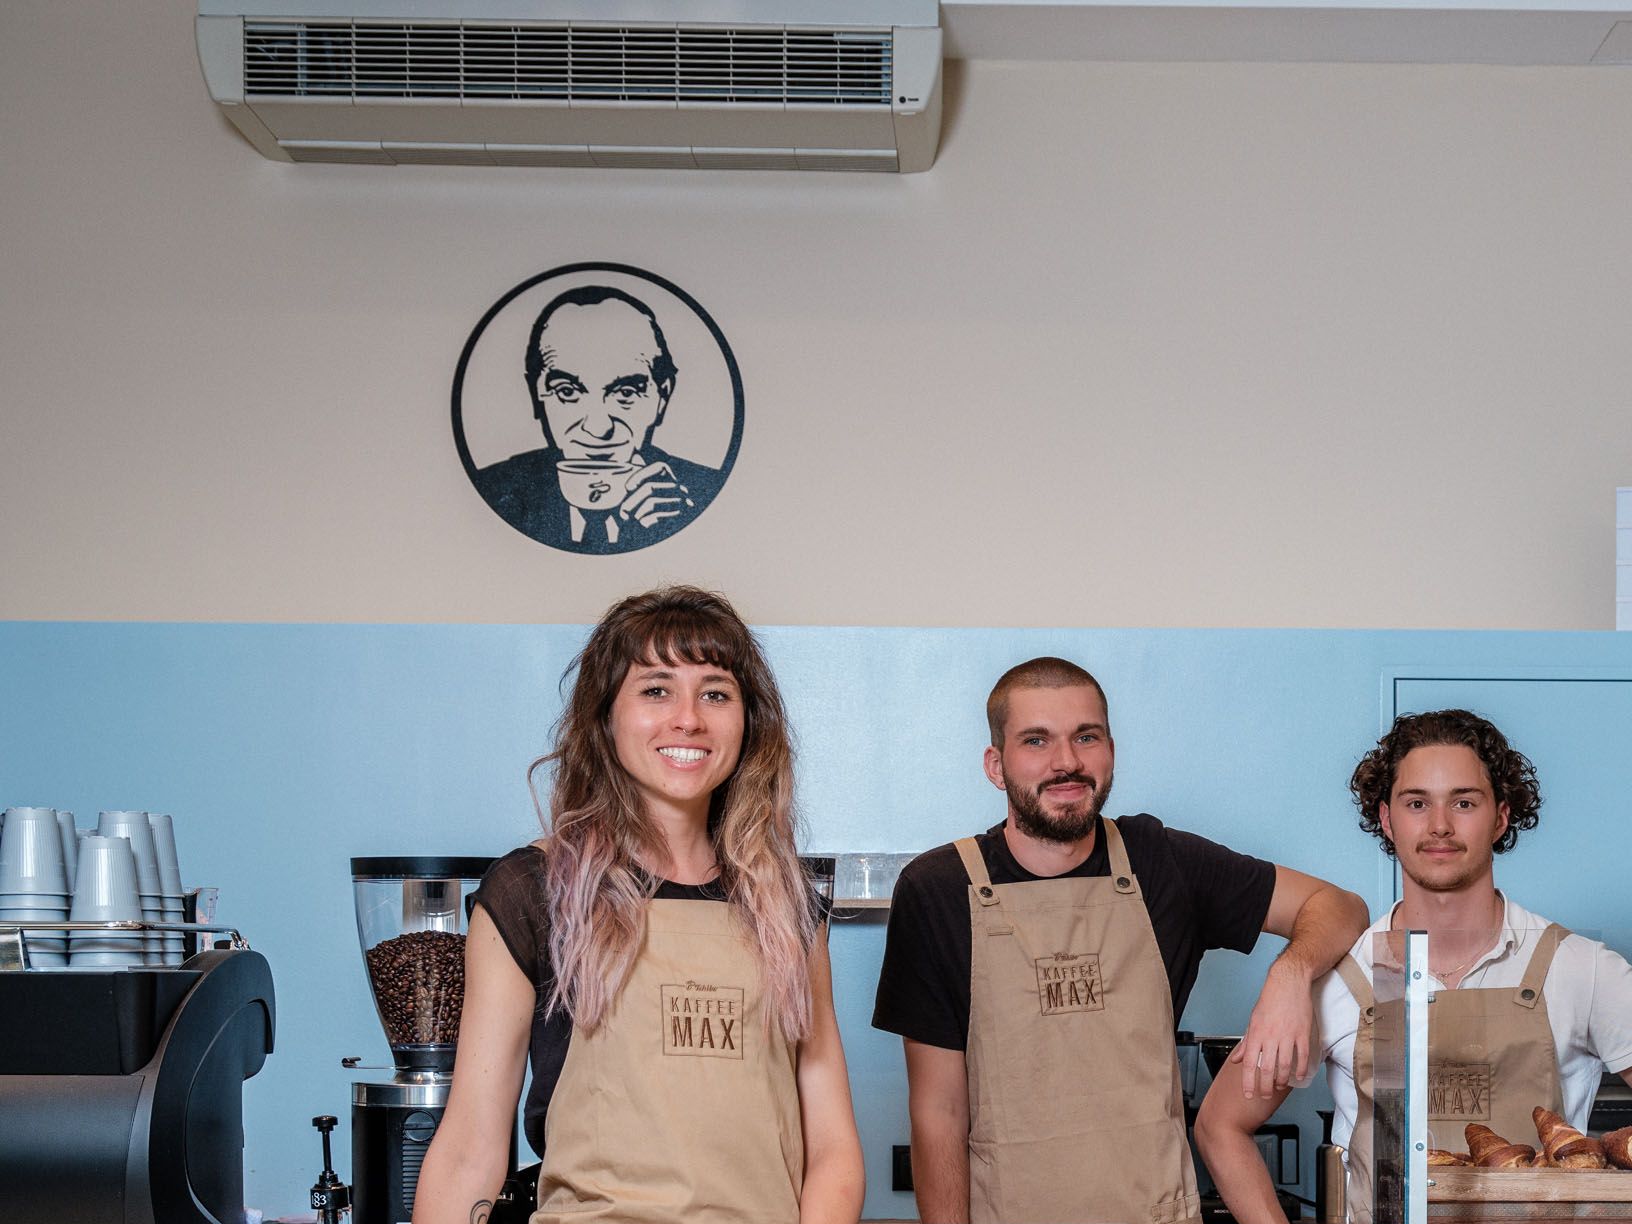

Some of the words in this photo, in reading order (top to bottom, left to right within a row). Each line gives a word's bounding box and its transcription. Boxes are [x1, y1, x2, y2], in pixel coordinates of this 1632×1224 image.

[1044, 964, 1096, 980] KAFFEE
[671, 996, 735, 1015] KAFFEE
[1046, 979, 1096, 1008] MAX
[672, 1016, 735, 1050] MAX
[1429, 1088, 1483, 1114] MAX
